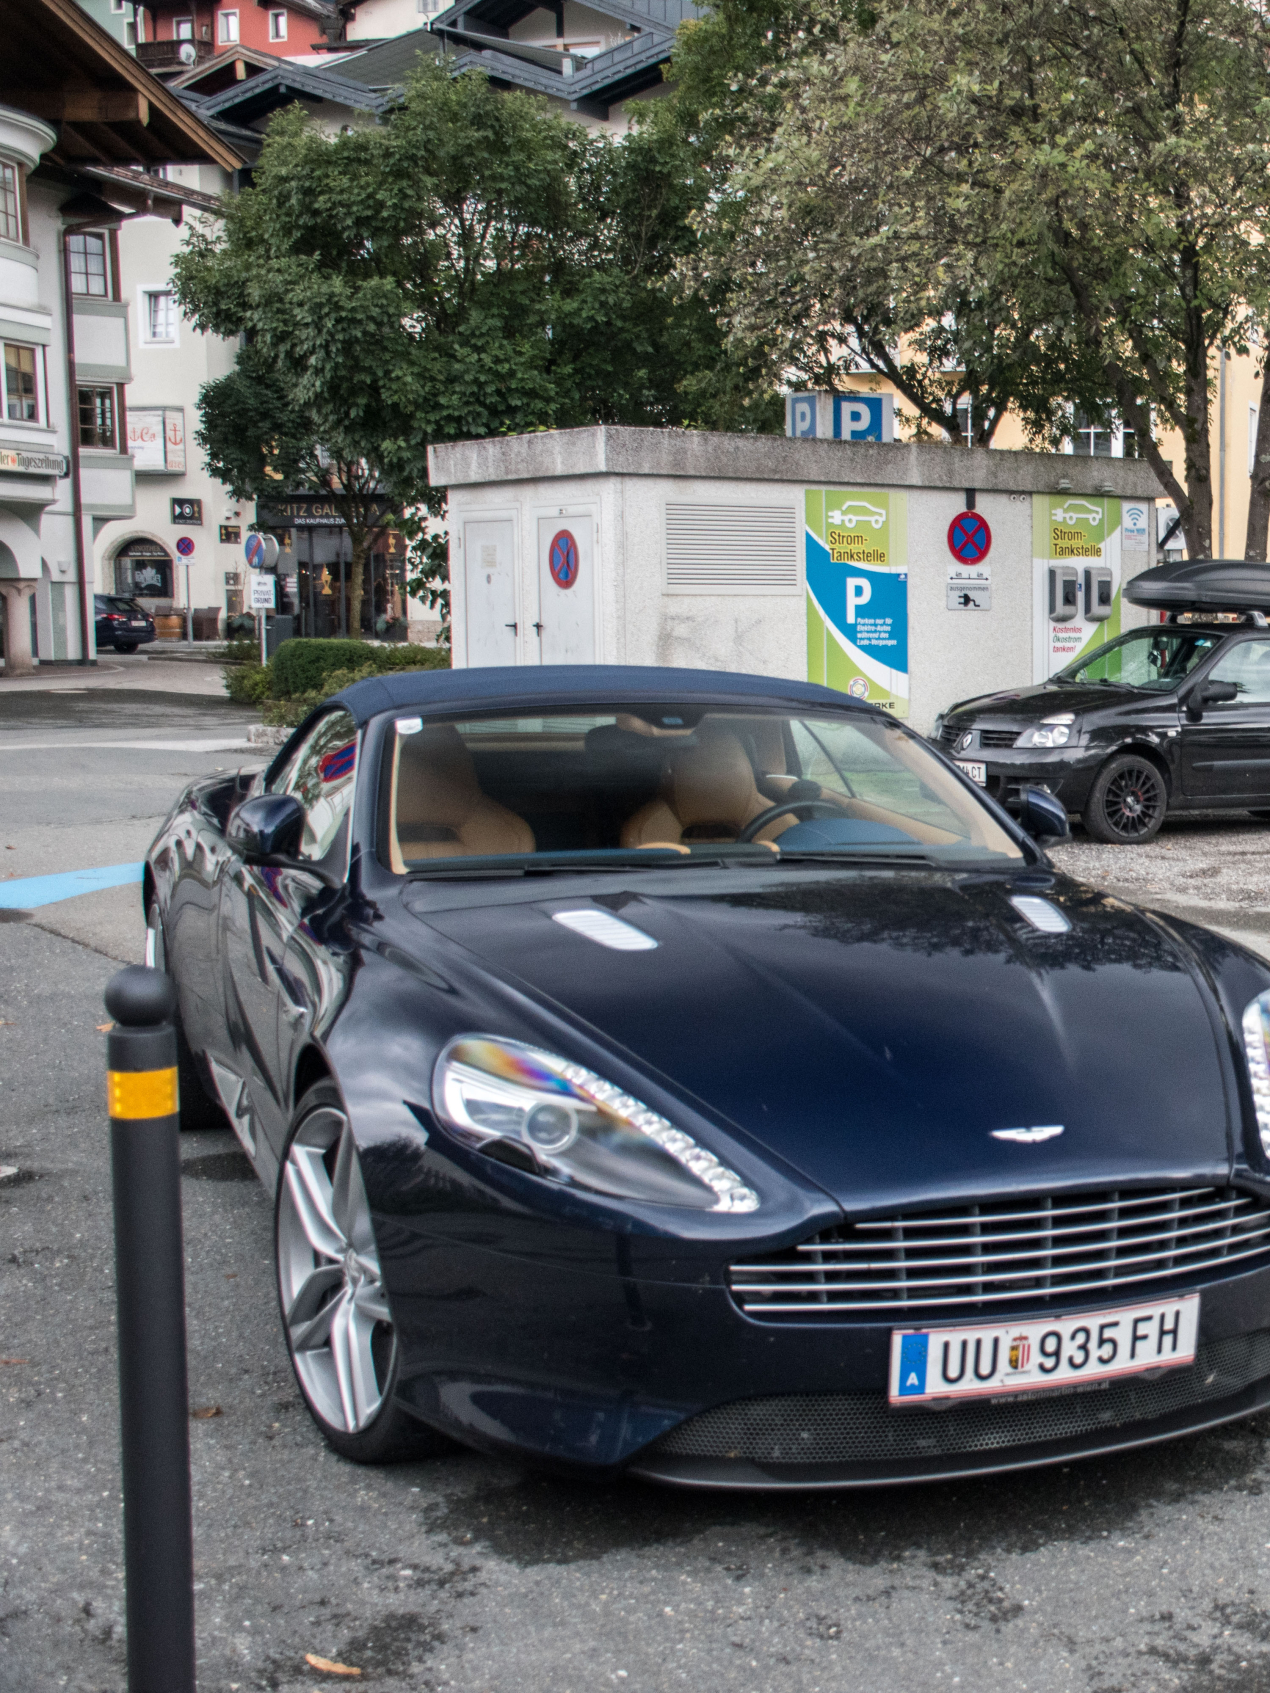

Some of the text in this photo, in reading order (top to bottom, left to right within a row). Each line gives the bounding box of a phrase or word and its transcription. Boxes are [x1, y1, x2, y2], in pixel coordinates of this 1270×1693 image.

[795, 402, 811, 437] P
[841, 401, 871, 440] P
[16, 453, 64, 473] Tageszeitung
[278, 503, 308, 516] KITZ
[294, 517, 306, 525] DAS
[307, 517, 335, 525] KAUFHAUS
[829, 531, 868, 546] Strom-
[1053, 528, 1087, 541] Strom-
[830, 548, 886, 563] Tankstelle
[1053, 543, 1102, 558] Tankstelle
[846, 577, 872, 624] P
[1053, 626, 1083, 634] Kostenlos
[1053, 634, 1082, 644] Ökostrom
[1053, 645, 1077, 653] tanken!
[971, 766, 982, 779] CT
[906, 1371, 919, 1386] A
[942, 1335, 1000, 1384] UU
[990, 1380, 1110, 1405] www.astonmartin-wien.at
